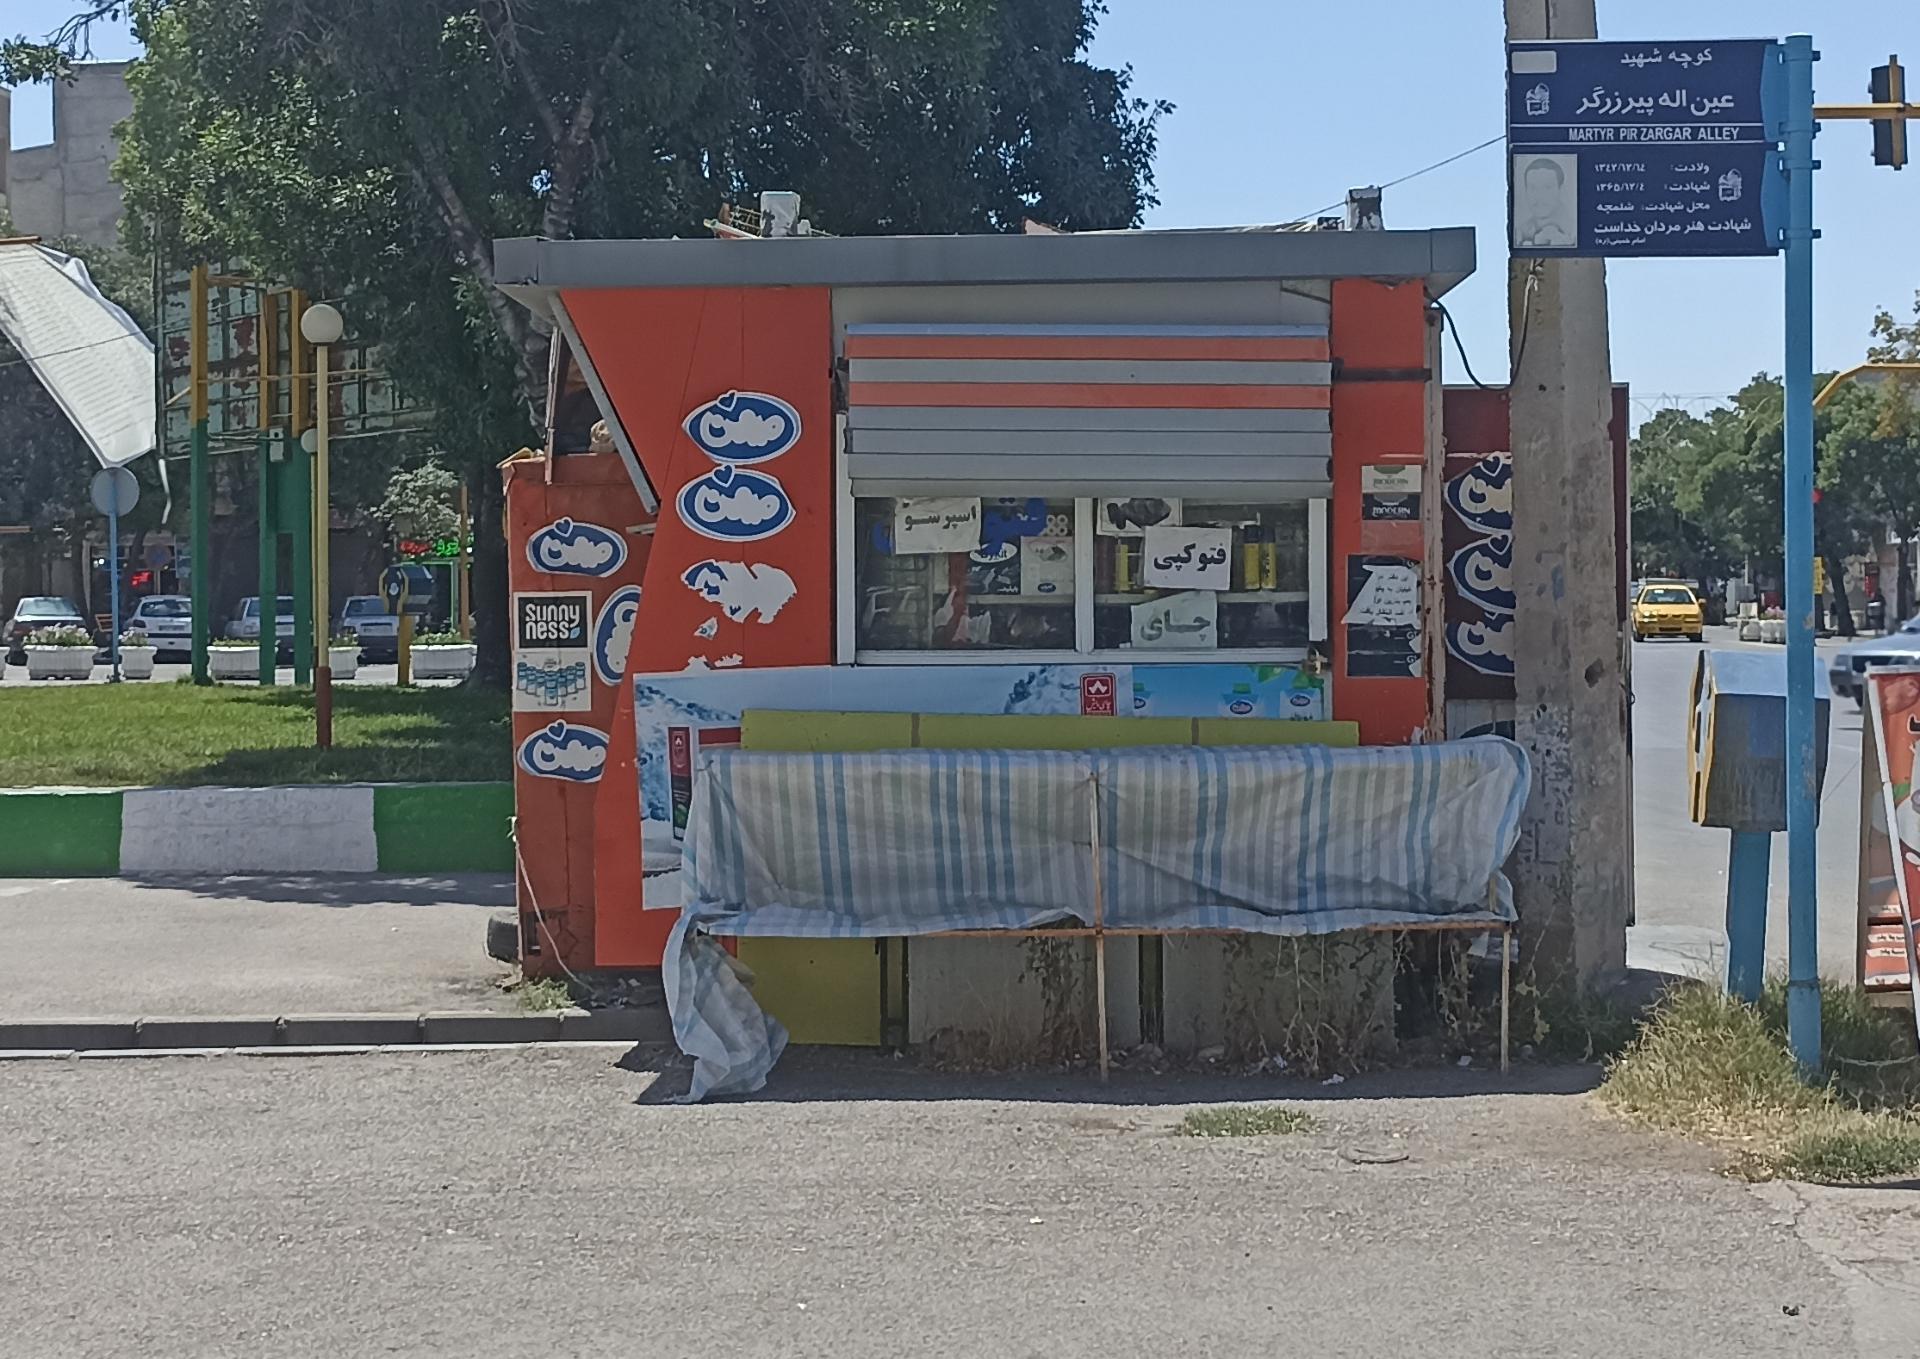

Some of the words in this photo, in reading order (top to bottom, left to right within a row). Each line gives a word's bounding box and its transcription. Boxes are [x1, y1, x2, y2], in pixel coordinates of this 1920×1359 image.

[1620, 48, 1662, 68] شهید
[1668, 48, 1712, 69] کوچه
[1658, 89, 1687, 108] اله
[1690, 94, 1735, 116] عین
[1568, 128, 1614, 141] MARTYR
[1697, 127, 1739, 140] ALLEY
[1596, 202, 1634, 214] شلمچه
[1686, 201, 1710, 214] محل
[1594, 221, 1641, 234] خداست
[1644, 220, 1681, 235] مردان
[1684, 220, 1705, 234] هنر
[1707, 217, 1752, 234] شهادت
[1140, 609, 1211, 642] چای
